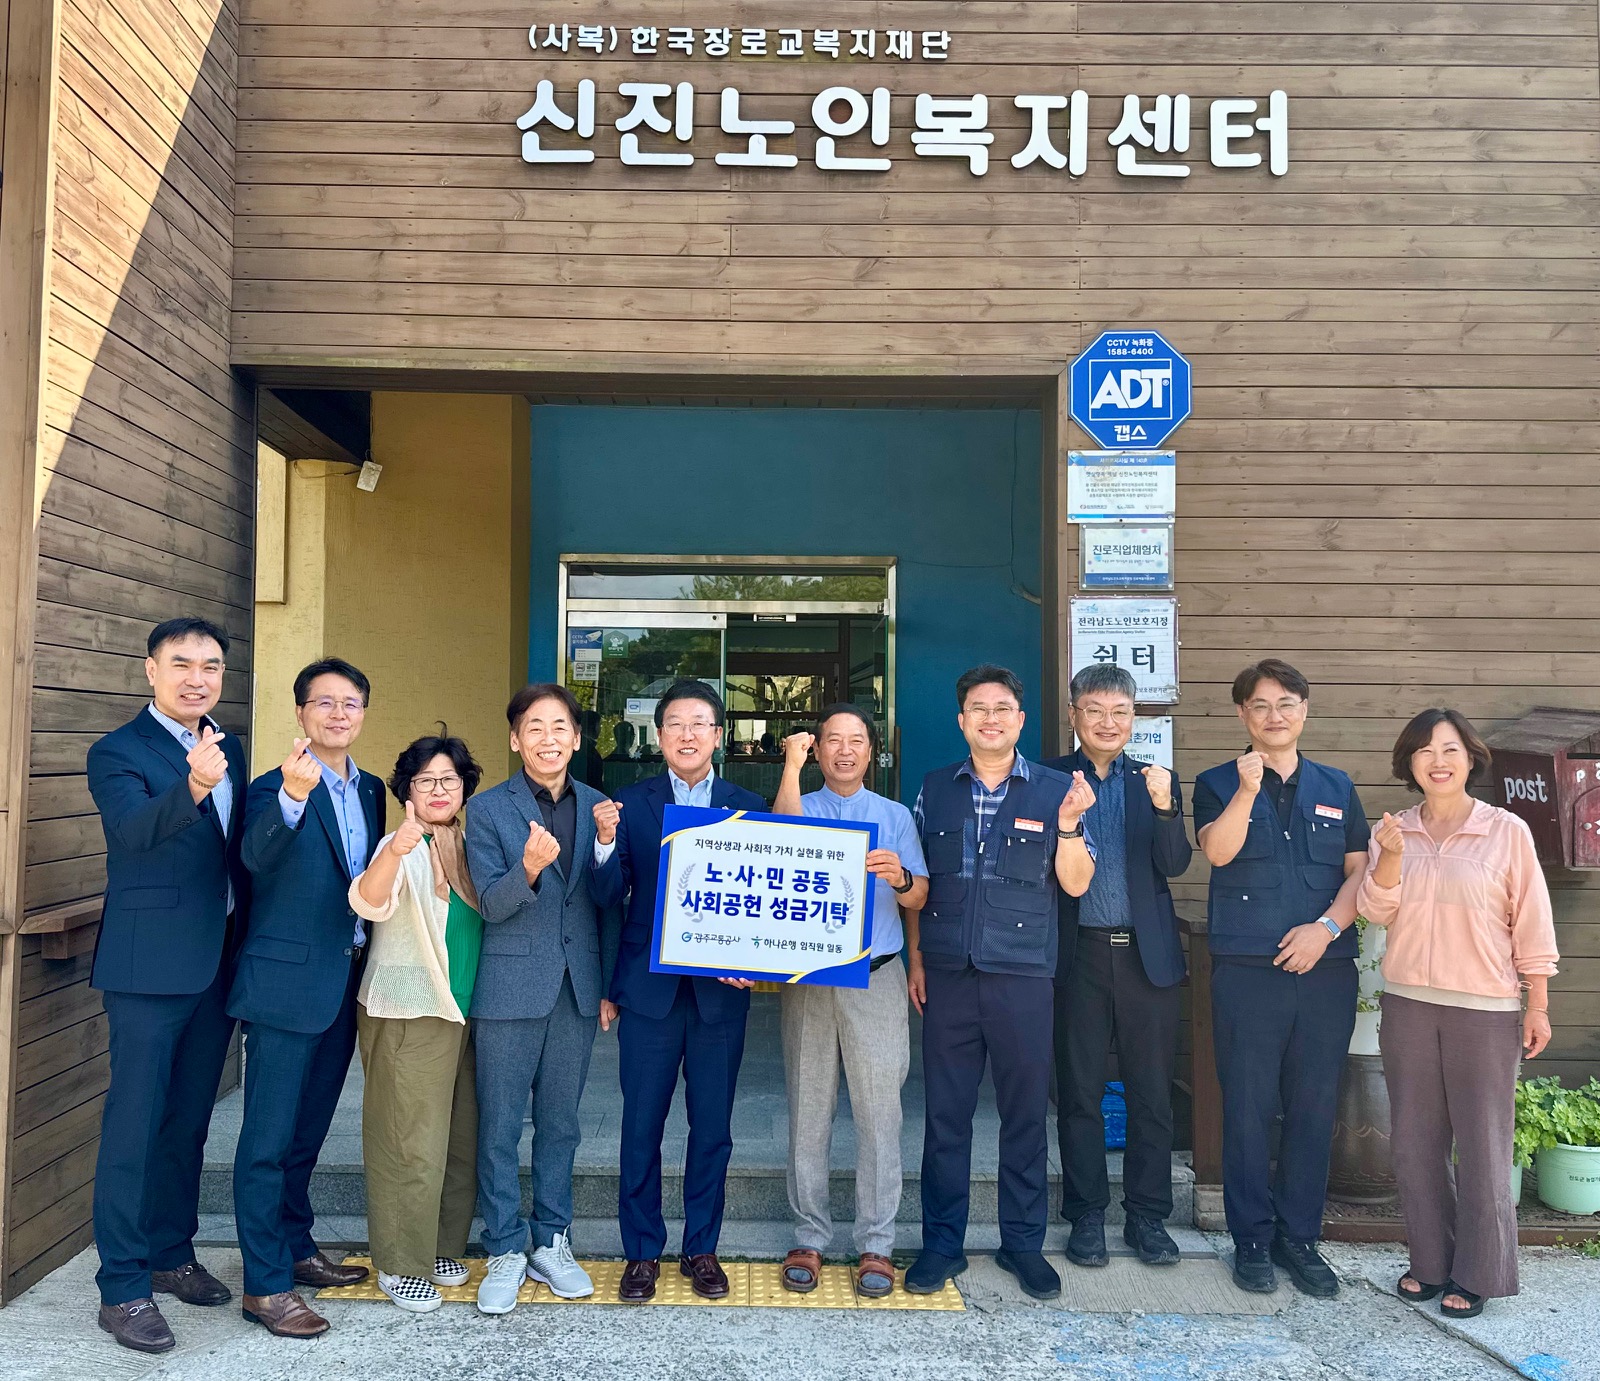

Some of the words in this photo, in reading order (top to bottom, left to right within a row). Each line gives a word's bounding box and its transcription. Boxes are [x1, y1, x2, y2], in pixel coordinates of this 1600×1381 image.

[527, 24, 618, 54] (사복)
[630, 28, 952, 60] 한국장로교복지재단
[515, 78, 1289, 177] 신진노인복지센터
[1106, 339, 1130, 347] CCTV
[1106, 348, 1154, 356] 1588-6400
[1090, 368, 1172, 409] ADT
[1114, 424, 1147, 442] 캡스
[1093, 544, 1161, 556] 진로직업체험처
[1078, 616, 1169, 627] 전라남도노인보호지정
[1130, 644, 1155, 674] 터
[1504, 773, 1548, 804] post
[694, 838, 742, 852] 지역상생과
[744, 843, 772, 855] 사회적
[775, 845, 793, 857] 가치
[796, 848, 823, 860] 실현을
[826, 850, 845, 861] 위한
[791, 869, 831, 895] 공동
[681, 889, 761, 918] 사회공헌
[769, 897, 850, 925] 성금기탁
[694, 933, 741, 945] 광주교통공사
[764, 938, 797, 951] 하나은행
[800, 941, 824, 952] 임직원
[826, 943, 843, 954] 일동
